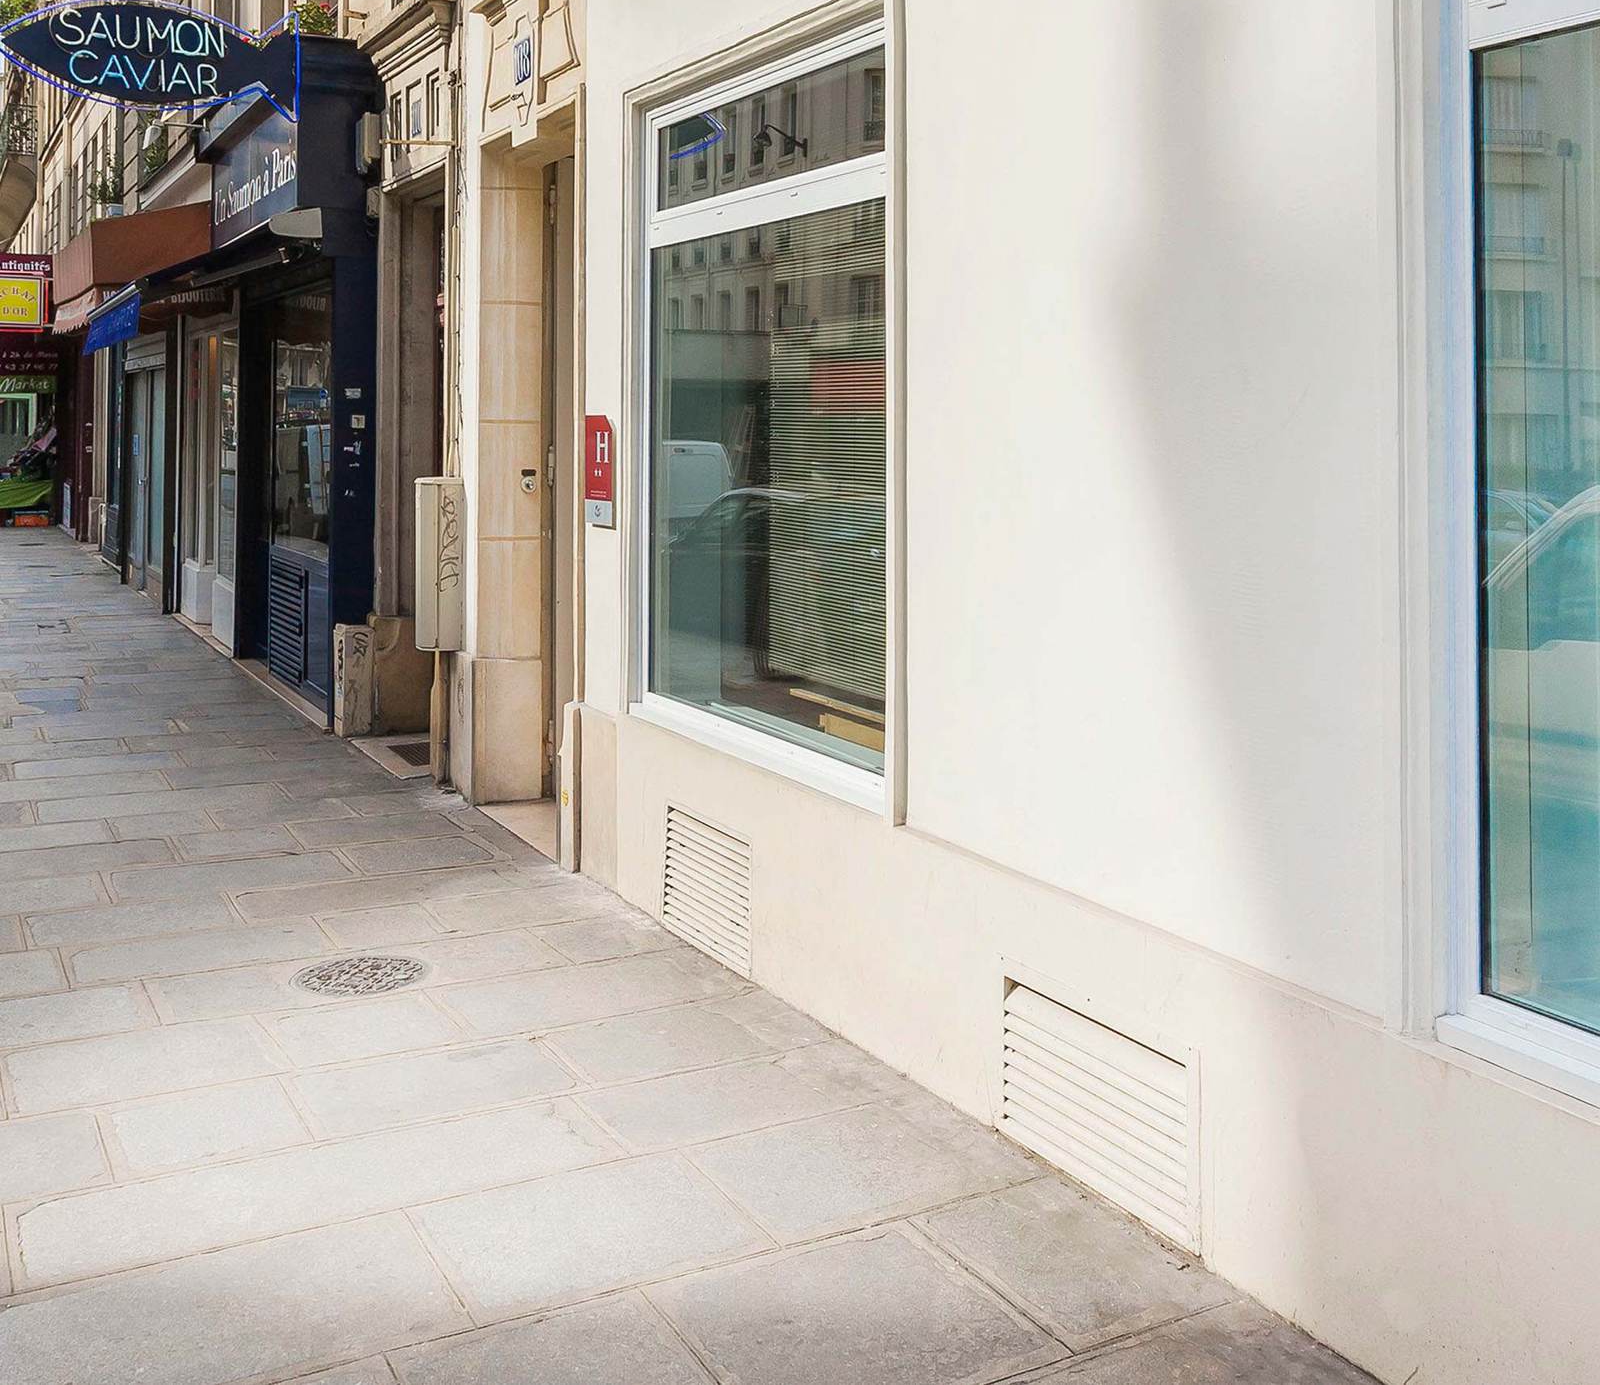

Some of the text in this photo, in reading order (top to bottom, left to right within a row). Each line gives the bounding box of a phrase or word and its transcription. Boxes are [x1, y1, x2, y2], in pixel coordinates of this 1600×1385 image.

[55, 9, 225, 58] SAUMON
[68, 50, 219, 96] CAVIAR
[0, 260, 51, 272] ntiquités
[595, 431, 610, 464] H
